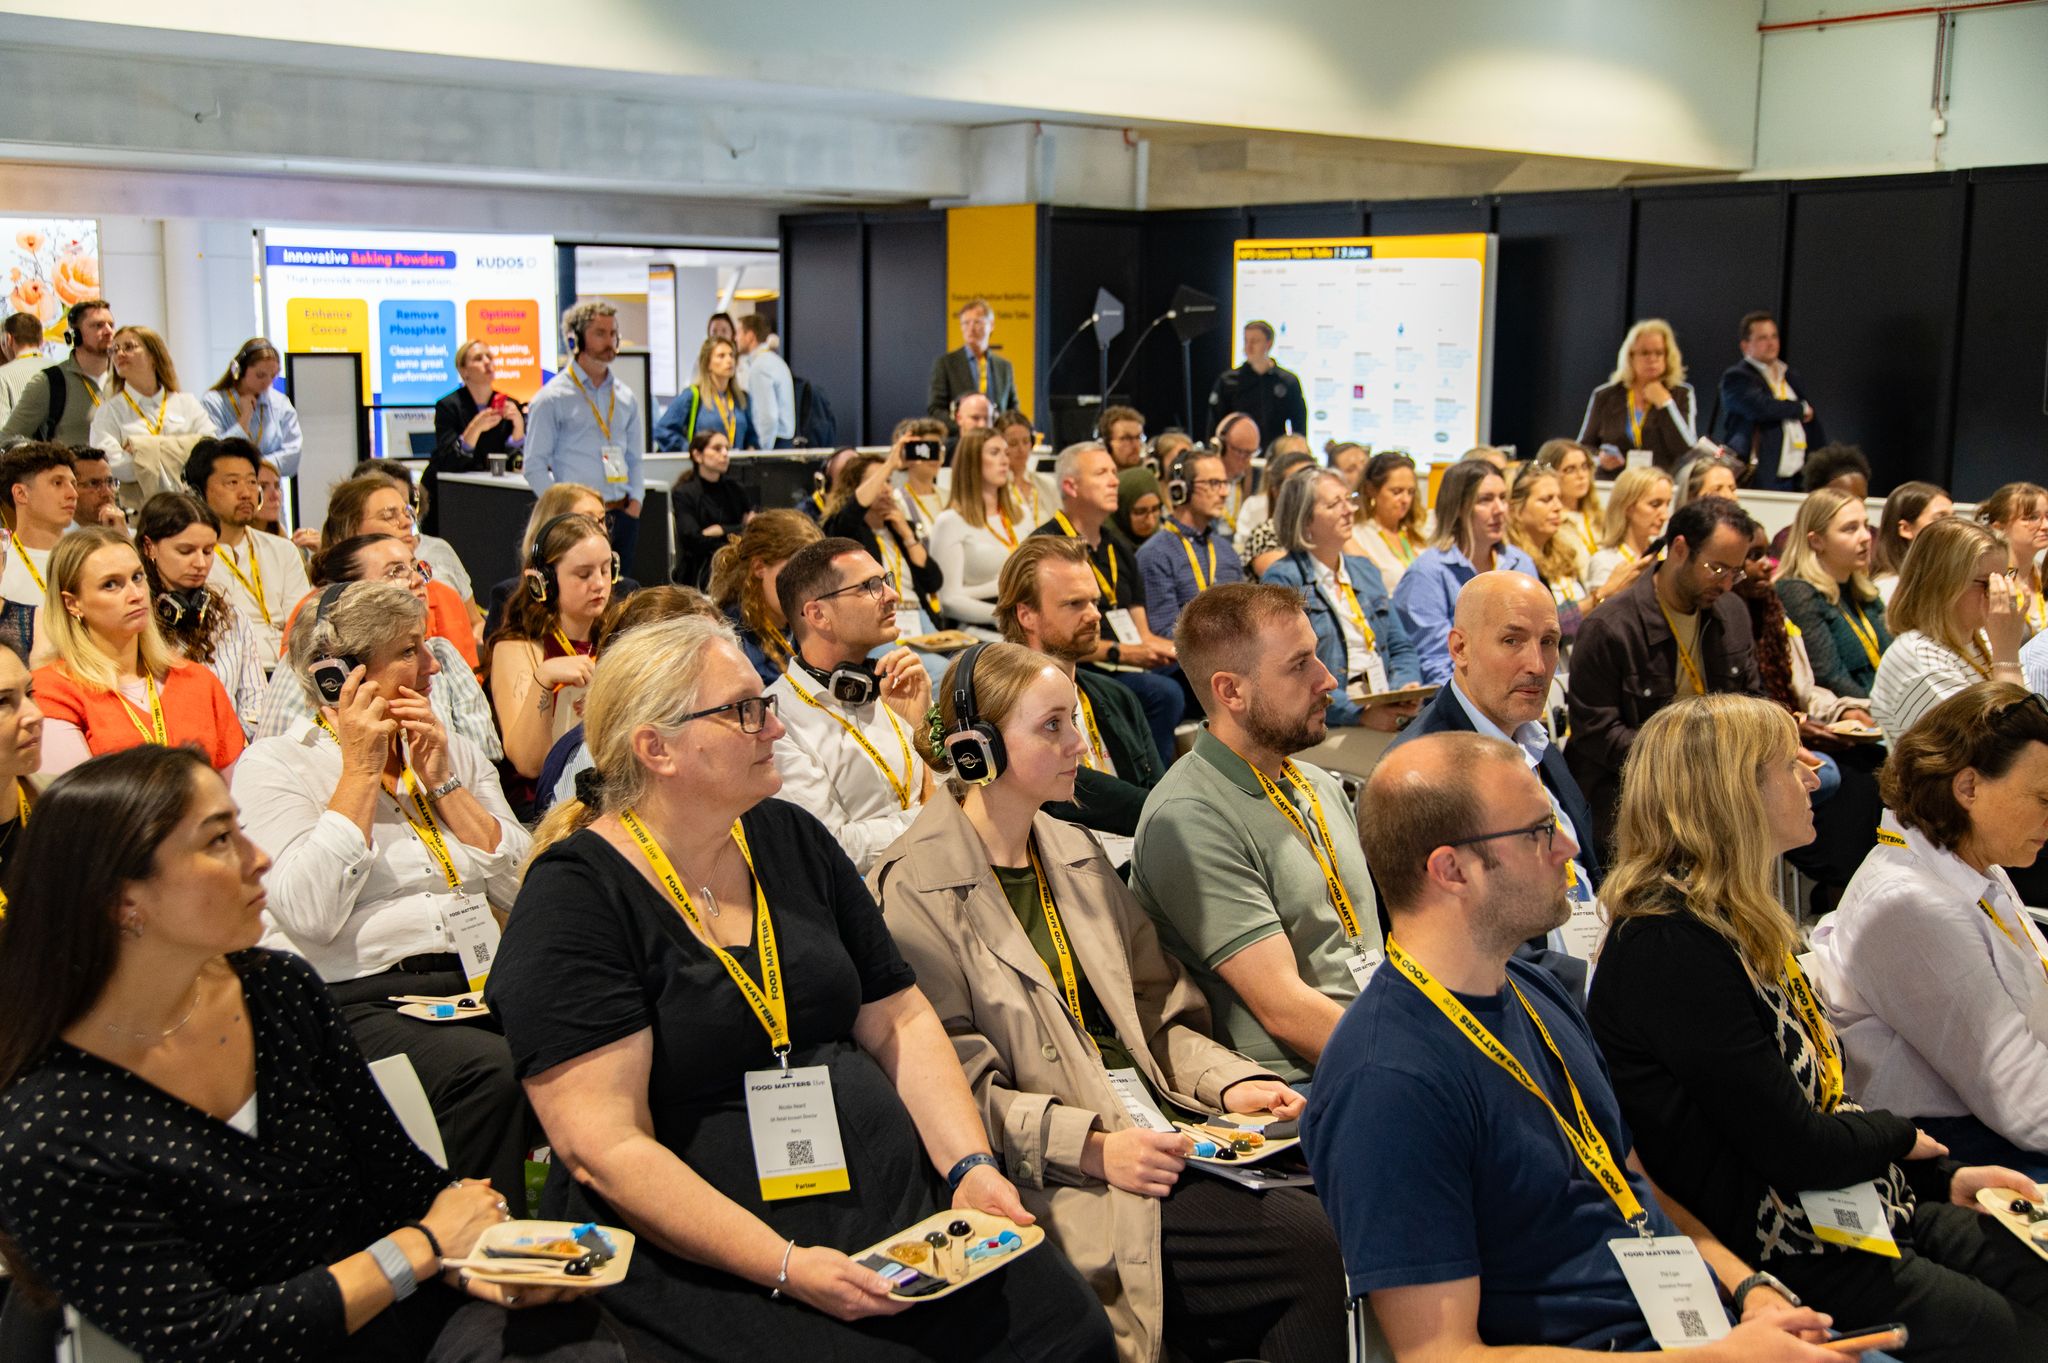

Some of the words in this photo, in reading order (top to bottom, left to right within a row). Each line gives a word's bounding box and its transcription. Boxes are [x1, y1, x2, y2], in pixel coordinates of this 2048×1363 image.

[283, 249, 349, 265] Innovative
[352, 251, 392, 268] Baking
[394, 253, 446, 266] Powders
[476, 257, 524, 269] KUDOS
[304, 309, 352, 319] Enhance
[396, 310, 440, 320] Remove
[311, 324, 348, 335] Cocoa
[389, 324, 447, 337] Phosphate
[486, 324, 520, 335] Colour
[488, 344, 530, 356] ng-lasting,
[391, 370, 448, 384] performance
[495, 370, 520, 380] olours
[1282, 760, 1303, 787] MATTER
[1258, 773, 1275, 794] FOOD
[1274, 795, 1303, 831] MATTERS
[1301, 783, 1317, 802] FOOD
[414, 793, 433, 827] MATTERS
[645, 844, 658, 860] live
[665, 874, 685, 902] FOOD
[1042, 886, 1059, 929] MATTERS
[1329, 877, 1342, 901] FOOD
[1339, 902, 1358, 938] MATTER
[762, 919, 775, 968] MATTERS
[1055, 931, 1067, 955] FOOD
[1402, 959, 1429, 985] FOOD
[722, 954, 745, 981] FOOD
[743, 982, 778, 1029] MATTERS
[771, 971, 780, 1001] FOOD
[1792, 977, 1809, 1007] FOOD
[1443, 997, 1461, 1017] live
[1459, 1014, 1506, 1061] MATTERS
[774, 1081, 811, 1090] MATTERS
[1507, 1059, 1533, 1088] FOOD
[1580, 1110, 1597, 1143] FOOD
[1601, 1168, 1623, 1195] FOOD
[1645, 1249, 1681, 1257] MATTERS
